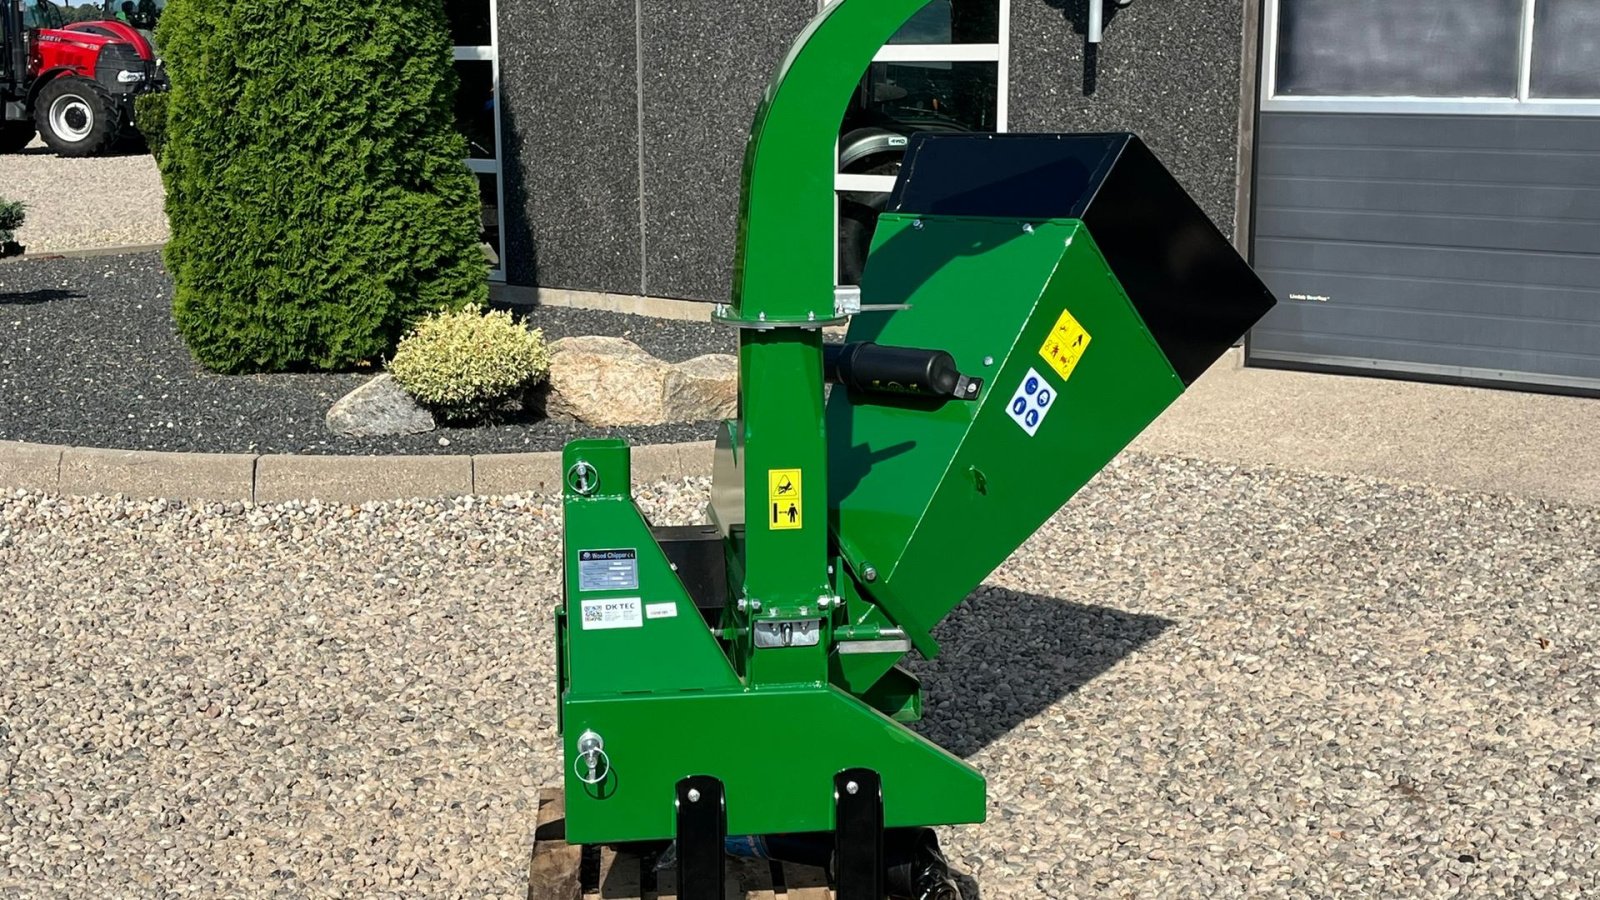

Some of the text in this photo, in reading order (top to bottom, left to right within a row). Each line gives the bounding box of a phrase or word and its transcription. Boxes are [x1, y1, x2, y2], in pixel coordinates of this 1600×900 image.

[607, 551, 627, 559] Chipper
[605, 602, 635, 611] DK TEC
